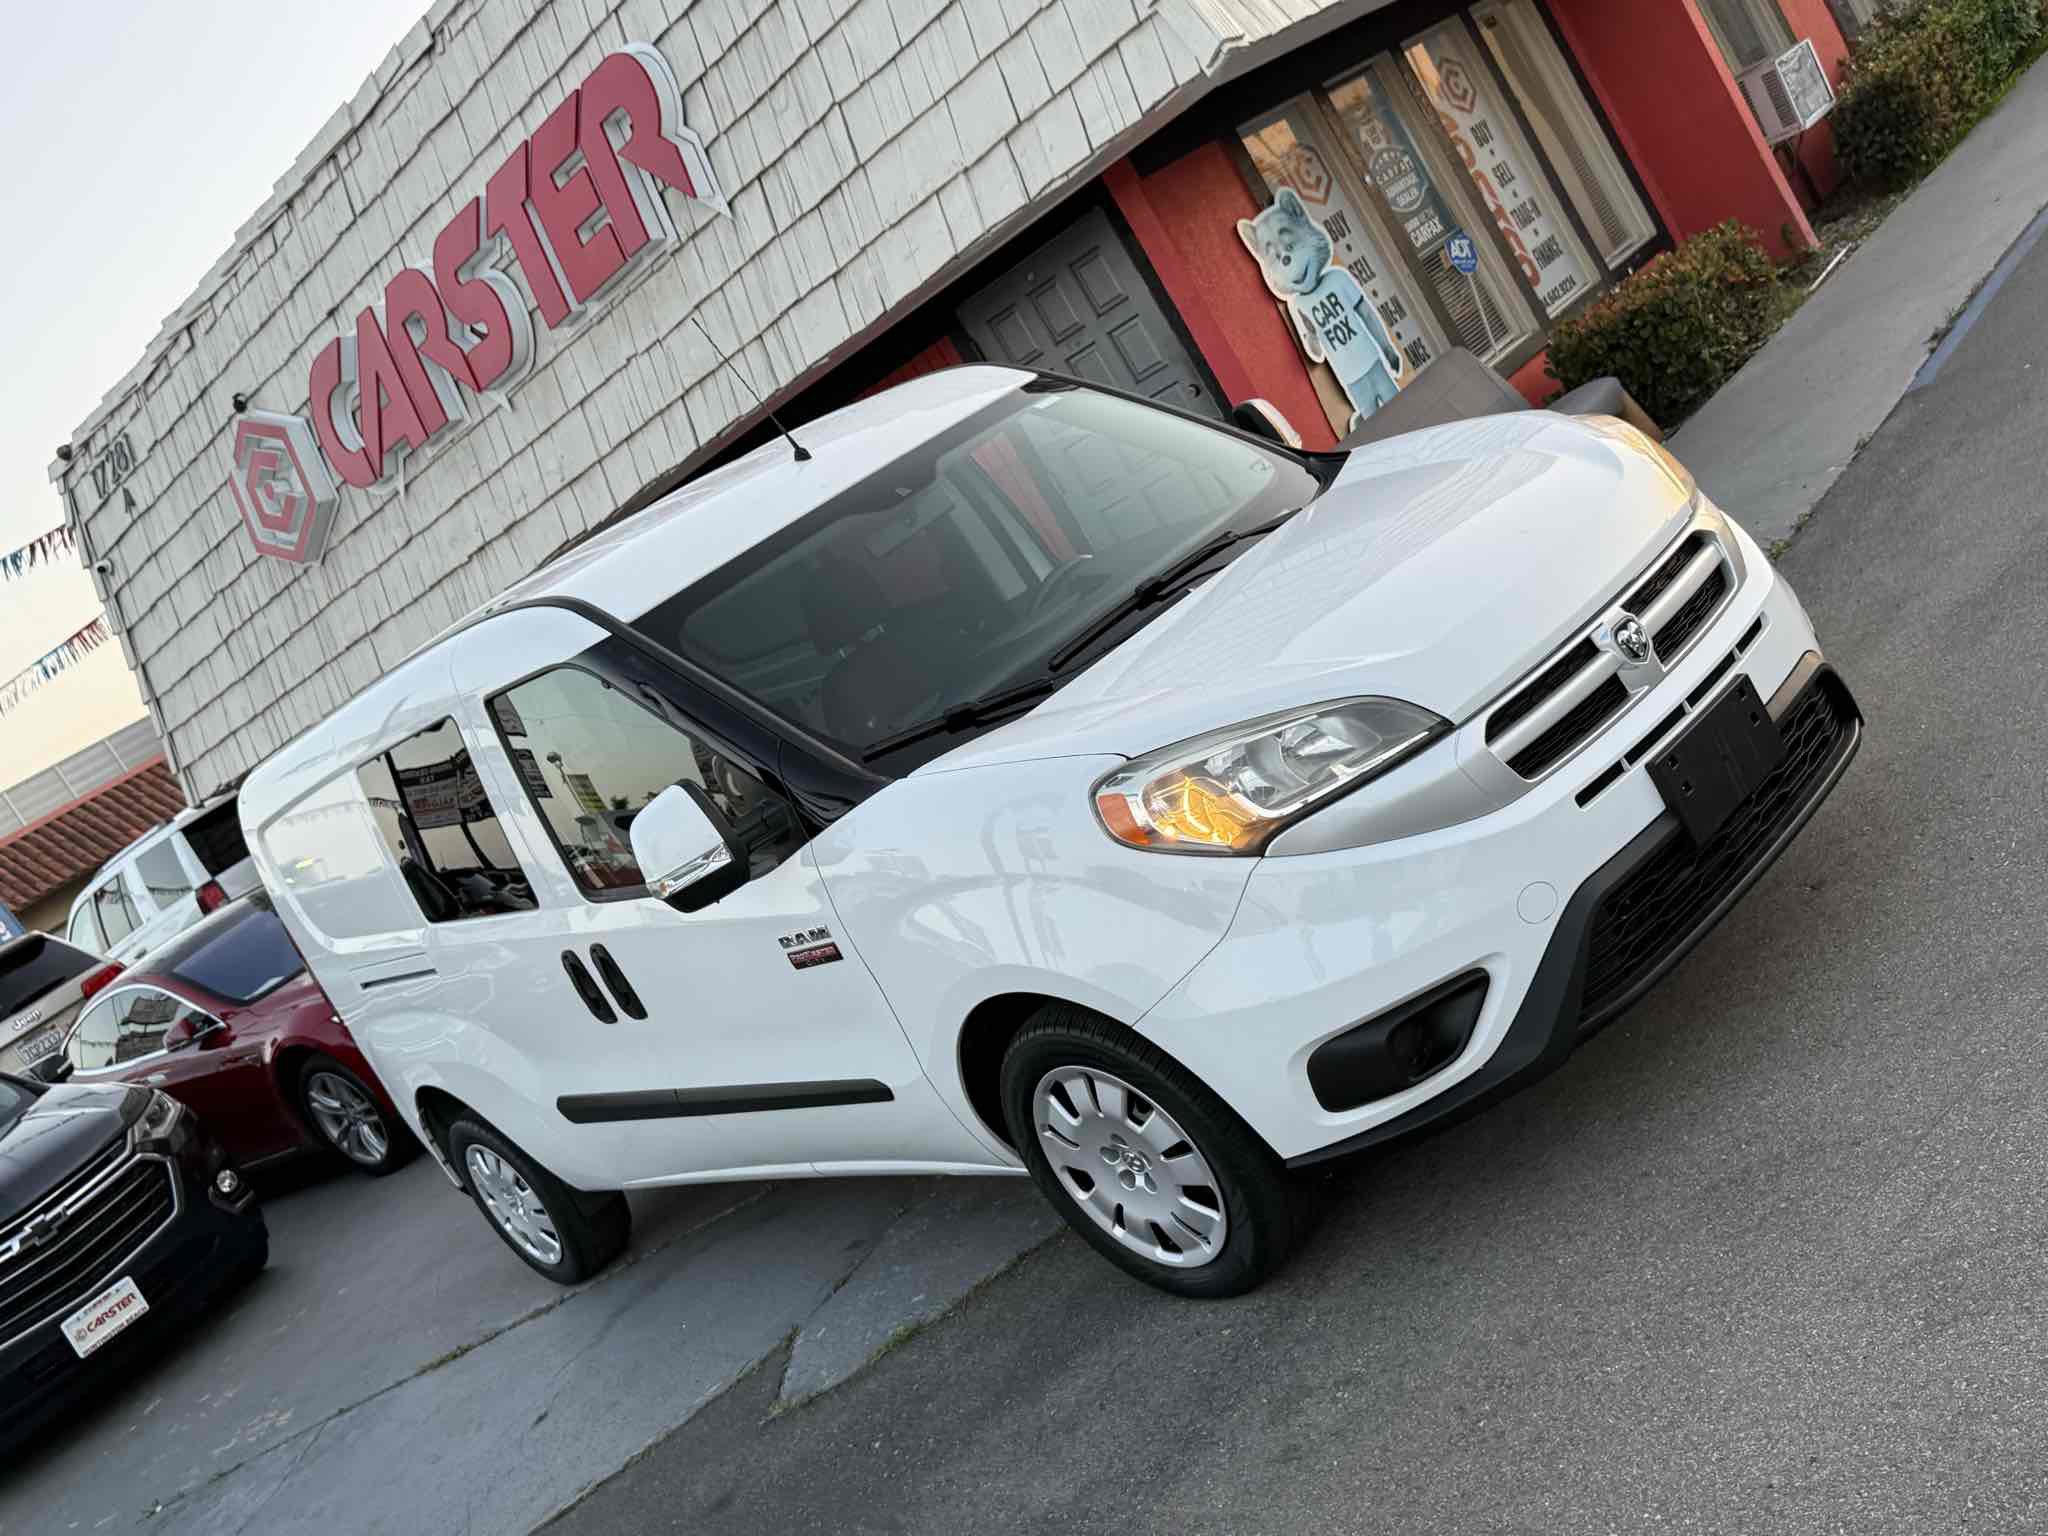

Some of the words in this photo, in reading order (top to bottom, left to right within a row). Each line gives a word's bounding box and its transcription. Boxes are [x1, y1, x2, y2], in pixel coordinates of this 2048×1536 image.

[1470, 119, 1493, 147] BUY
[1491, 160, 1515, 188] SELL
[1323, 209, 1351, 242] BUY
[1510, 198, 1542, 231] TRADE-IN
[1409, 217, 1443, 248] CARFAX
[1451, 238, 1472, 259] ADT
[309, 45, 720, 491] CARSTER
[1532, 233, 1563, 271] FINANCE
[1348, 256, 1376, 287] SELL
[1311, 292, 1345, 328] CAR
[1324, 315, 1357, 352] FOX
[778, 924, 833, 949] RAM
[13, 1008, 42, 1031] Jeep
[86, 1292, 136, 1333] CARSTER
